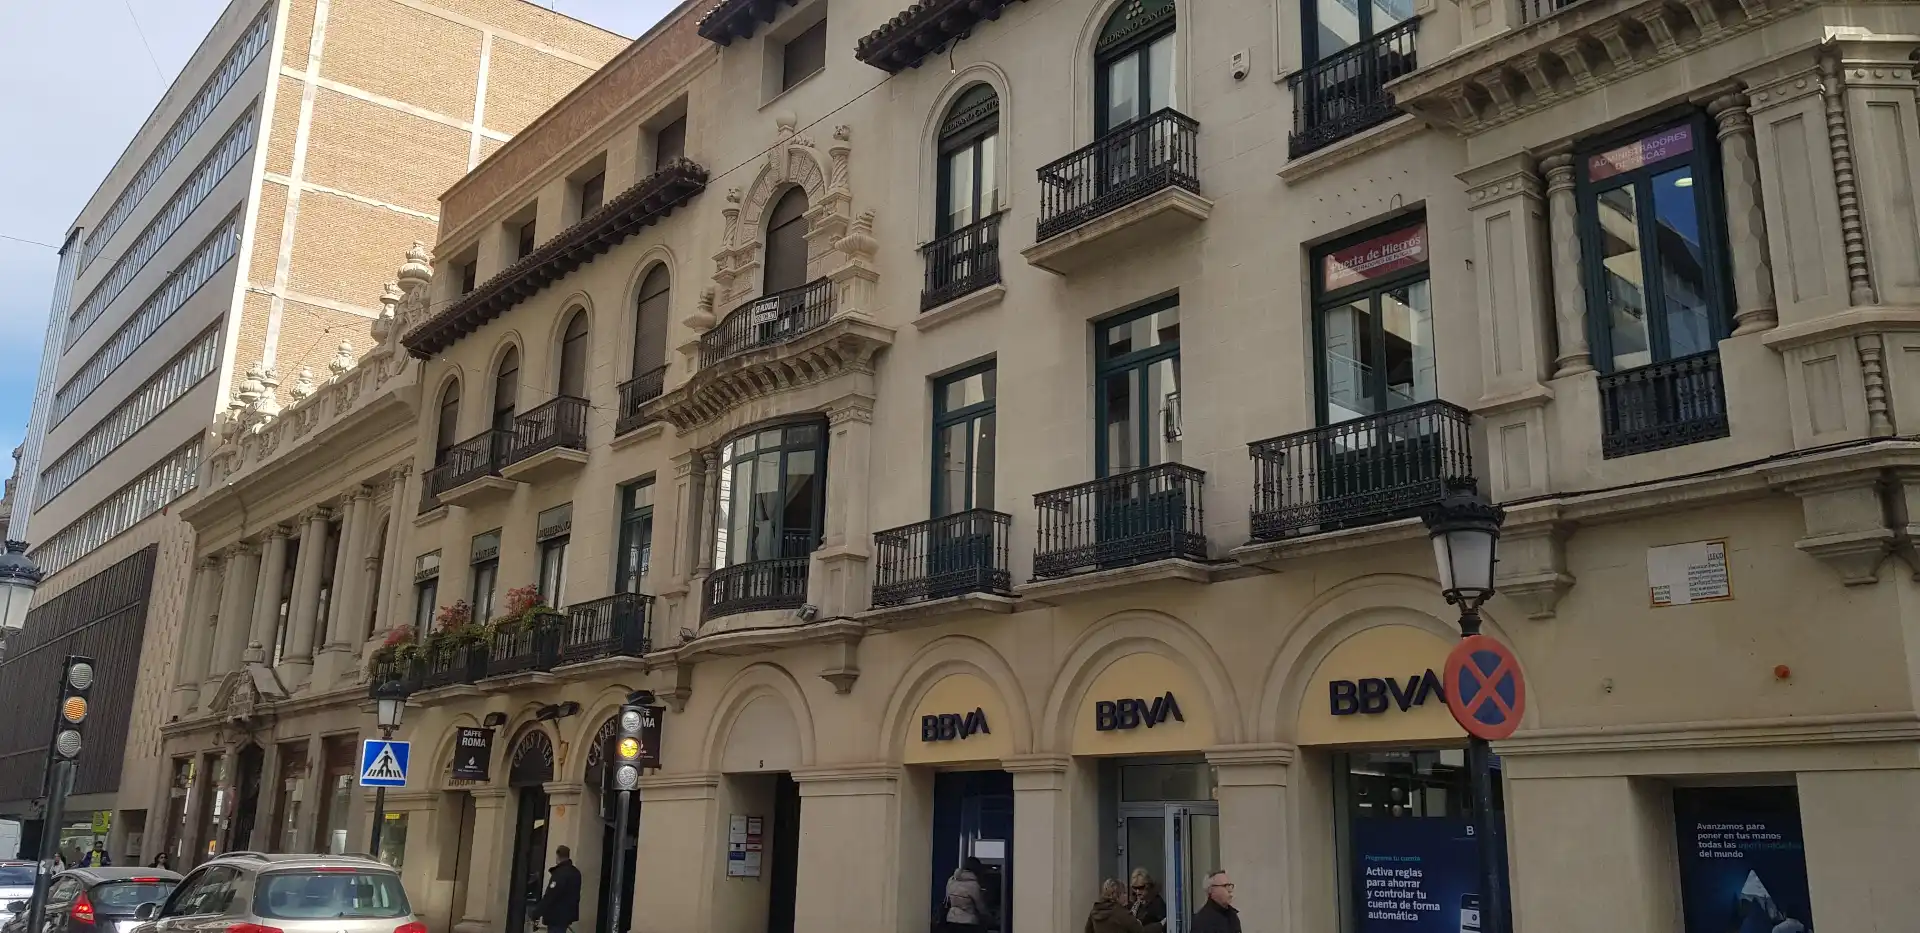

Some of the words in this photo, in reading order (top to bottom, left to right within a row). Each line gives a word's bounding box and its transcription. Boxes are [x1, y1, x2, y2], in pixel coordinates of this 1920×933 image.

[1594, 131, 1687, 168] ADMINISTRADORES
[1331, 255, 1364, 272] Puerta
[1367, 247, 1380, 263] de
[1382, 236, 1421, 256] Hierros
[1329, 668, 1446, 715] BBVA
[1096, 691, 1185, 731] BBVA
[921, 707, 991, 742] BBVA
[463, 730, 483, 738] CAFFE
[462, 738, 486, 748] ROMA
[759, 760, 764, 768] 5
[1699, 850, 1712, 858] del
[1714, 850, 1743, 858] mundo
[1366, 866, 1393, 876] Activa
[1395, 867, 1422, 879] reglas
[1366, 879, 1386, 888] para
[1388, 878, 1420, 888] ahorrar
[1367, 890, 1372, 899] y
[1374, 889, 1414, 899] controlar
[1417, 891, 1427, 899] tu
[1367, 900, 1397, 909] cuenta
[1399, 900, 1411, 909] de
[1413, 901, 1440, 911] forma
[1368, 911, 1418, 921] automática
